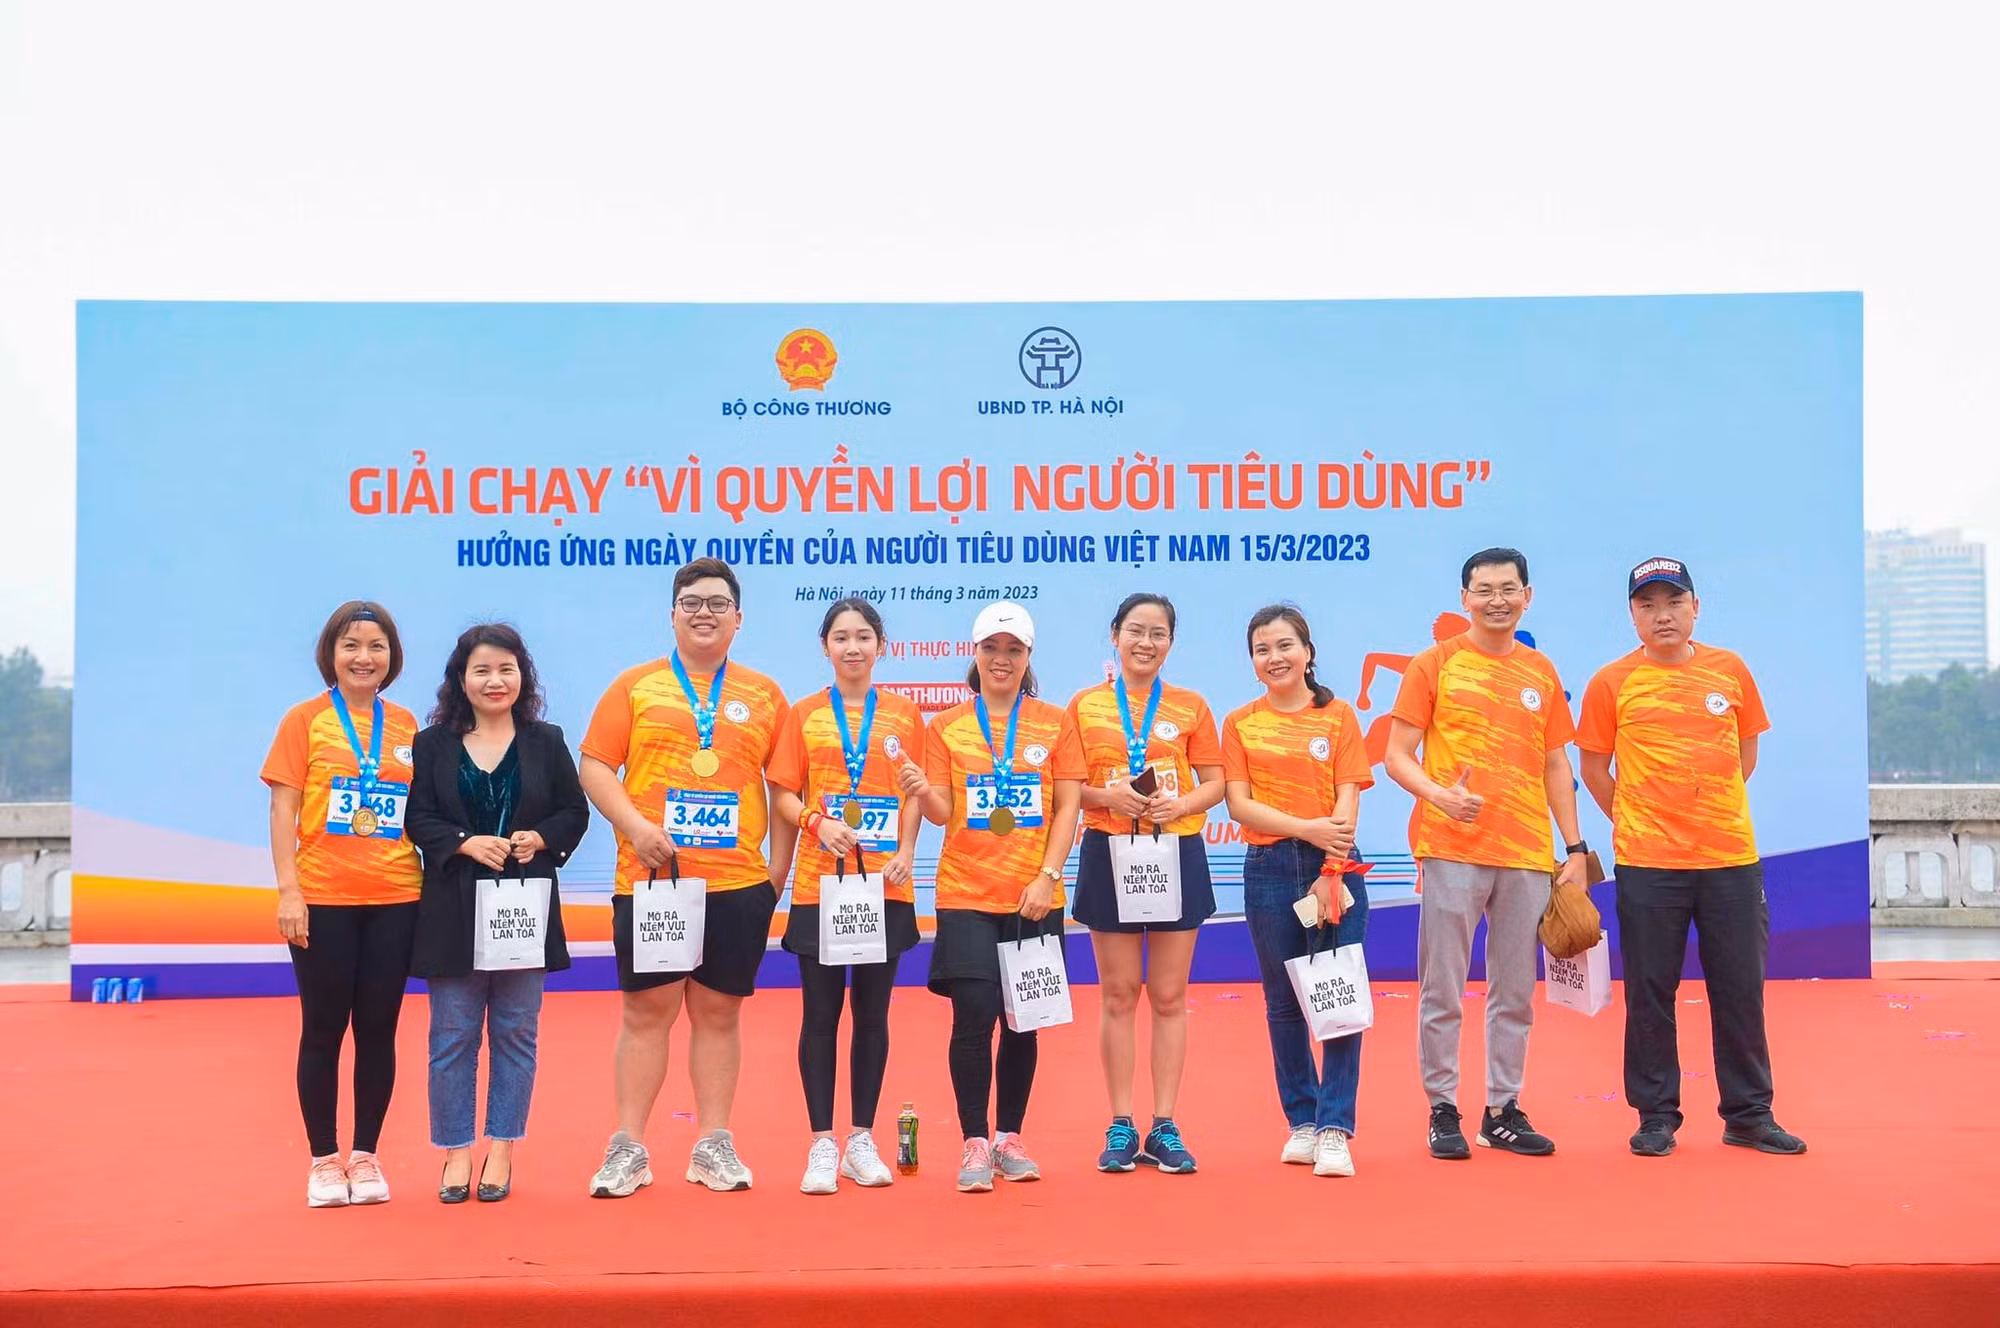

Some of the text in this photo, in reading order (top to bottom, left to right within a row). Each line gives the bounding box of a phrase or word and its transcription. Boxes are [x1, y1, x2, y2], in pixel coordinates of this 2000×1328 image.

[722, 398, 892, 420] BỘ CÔNG THƯƠNG
[978, 396, 1124, 418] UBND TP. HÀ NỘI
[350, 450, 454, 515] GIẢI
[469, 467, 612, 526] CHẠY
[716, 444, 894, 524] QUYỀN
[909, 458, 987, 524] LỢI
[1014, 451, 1175, 511] NGƯỜI
[1187, 450, 1303, 510] TIÊU
[457, 528, 1371, 569] HƯỞNG ỨNG NGÀY QUYỀN CỦA NGƯỜI TIÊU DÙNG VIỆT NAM 15/3/2023
[795, 586, 815, 601] Hà
[851, 586, 886, 604] ngày
[891, 586, 906, 600] 11
[910, 585, 953, 604] tháng
[956, 586, 965, 600] 3
[968, 586, 1000, 600] năm
[1003, 585, 1039, 600] 2023
[890, 641, 906, 661] VỊ
[909, 640, 951, 661] THỰC
[956, 641, 976, 657] HI
[339, 793, 396, 818] 3.68
[673, 804, 731, 828] 3.464
[1146, 864, 1160, 873] RA
[1150, 873, 1168, 883] VUI
[1126, 884, 1146, 894] LAN
[514, 907, 528, 918] RA
[856, 903, 871, 913] RA
[664, 910, 678, 921] RA
[859, 912, 879, 923] VUI
[518, 917, 537, 928] VUI
[667, 920, 686, 931] VUI
[492, 929, 513, 940] LAN
[835, 924, 856, 935] LAN
[642, 931, 662, 942] LAN
[1037, 966, 1052, 978] RA
[1567, 960, 1578, 972] RA
[1042, 974, 1062, 987] VUI
[1330, 976, 1346, 989] RA
[1551, 972, 1567, 985] LAN
[1570, 970, 1585, 983] VUI
[1019, 989, 1041, 1002] LAN
[1336, 983, 1356, 997] VUI
[1314, 999, 1336, 1013] LAN
